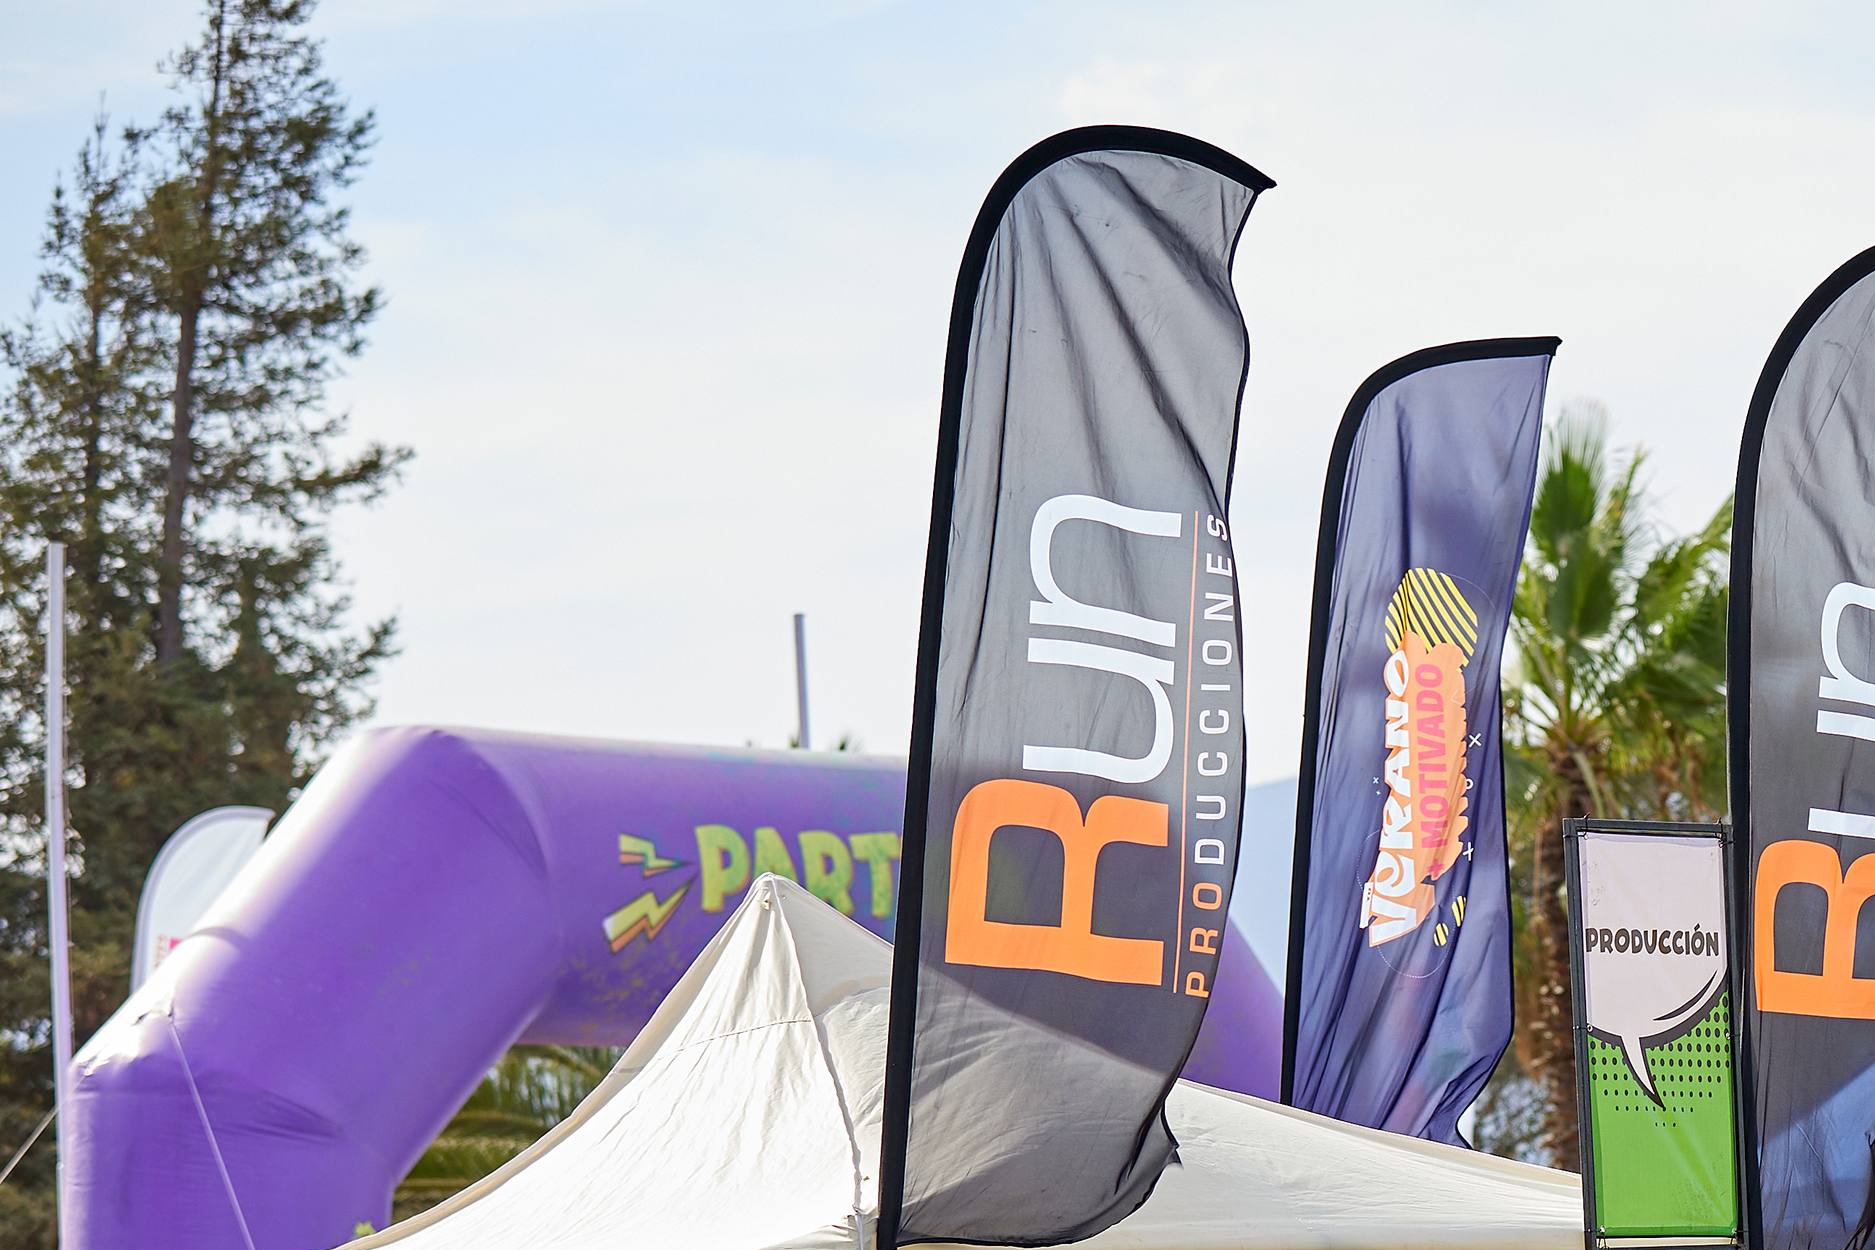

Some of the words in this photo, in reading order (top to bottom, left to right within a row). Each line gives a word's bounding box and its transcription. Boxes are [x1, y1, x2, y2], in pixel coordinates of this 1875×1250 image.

[945, 494, 1183, 986] Run
[1186, 513, 1232, 998] PRODUCCIONES
[1415, 663, 1449, 848] MOTIVADO
[694, 824, 903, 920] PART
[1584, 923, 1720, 957] PRODUCCIÓN
